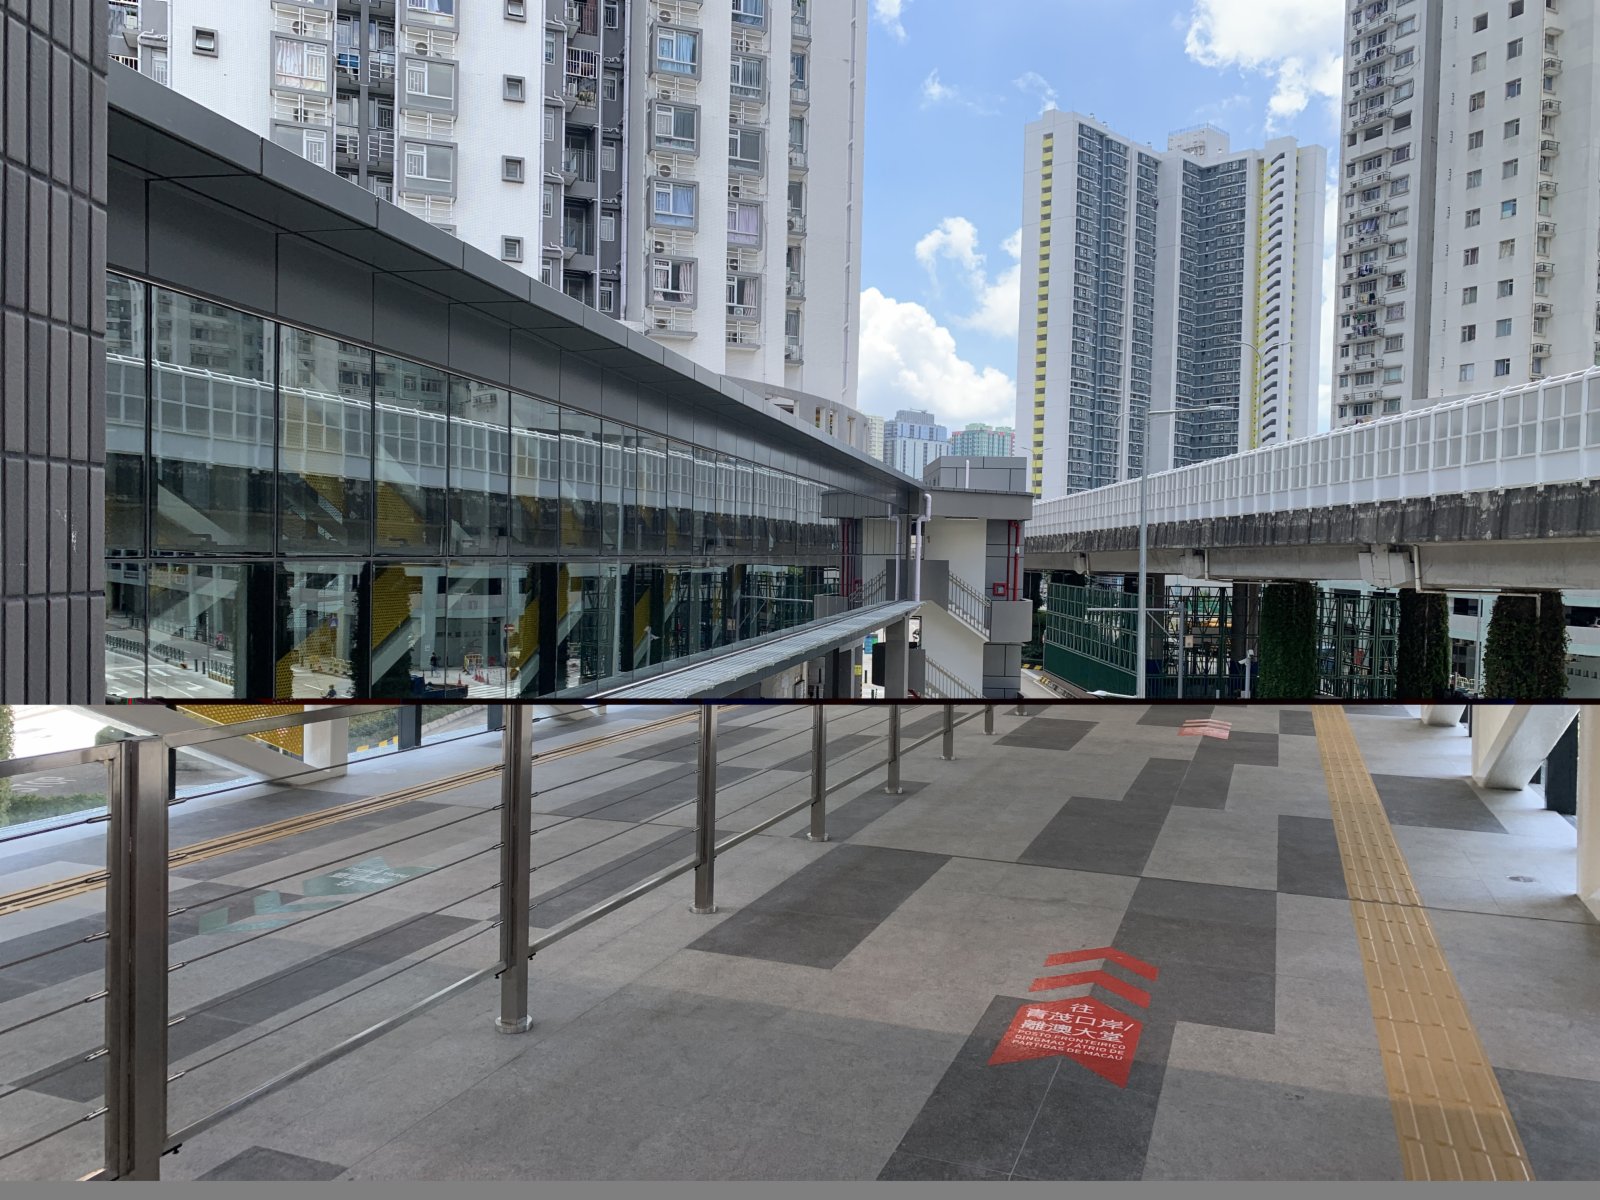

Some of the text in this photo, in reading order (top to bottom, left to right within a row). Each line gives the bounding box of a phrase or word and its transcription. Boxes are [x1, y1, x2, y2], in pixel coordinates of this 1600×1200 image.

[1070, 1003, 1095, 1015] 往
[1017, 1029, 1052, 1039] POSTO
[1020, 1019, 1124, 1043] 離澳大堂
[1011, 1039, 1123, 1061] PARTIDAS DE MACAU
[1014, 1034, 1065, 1046] QINGMAO
[1109, 1048, 1125, 1056] DE
